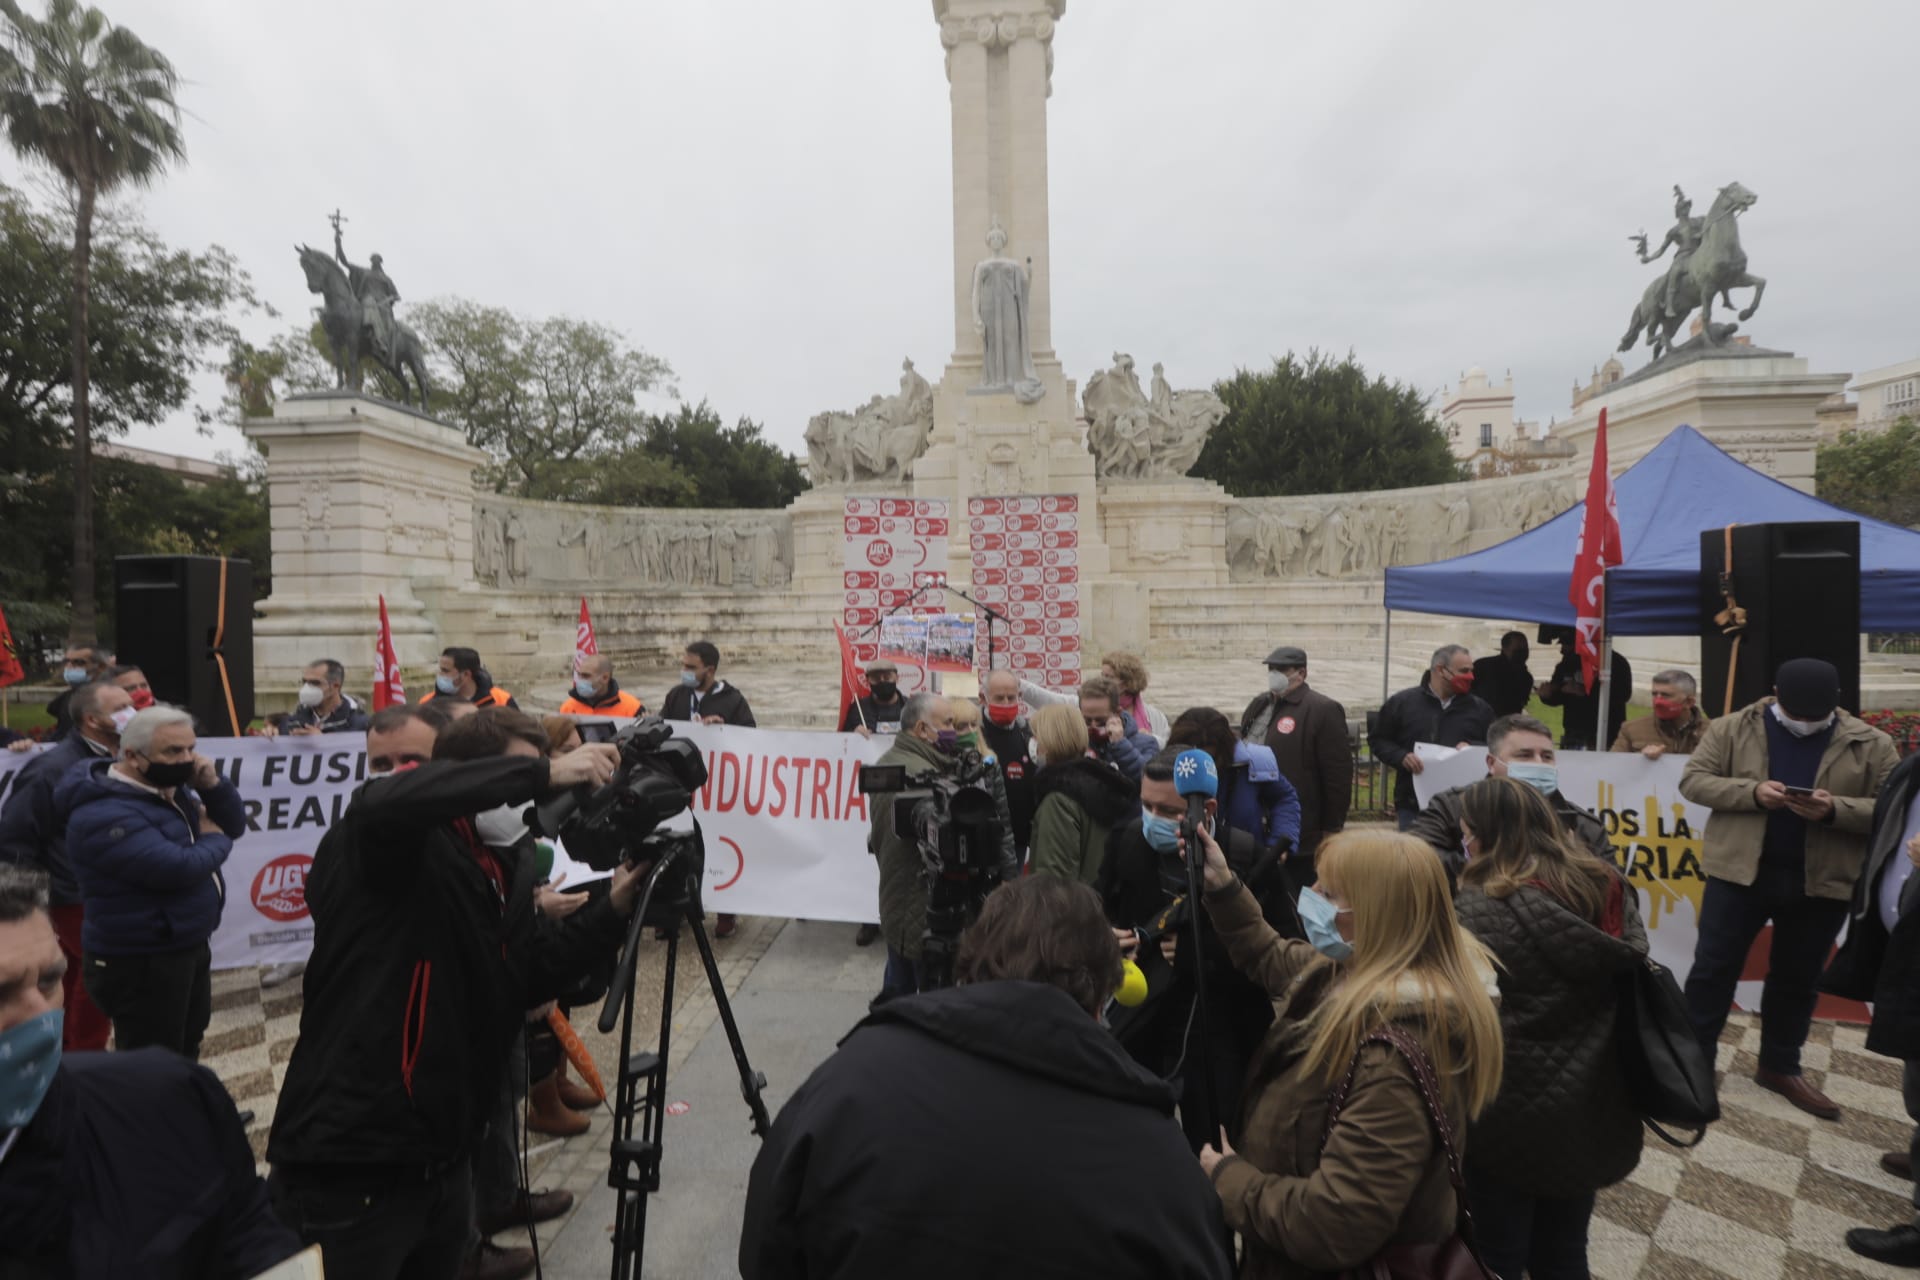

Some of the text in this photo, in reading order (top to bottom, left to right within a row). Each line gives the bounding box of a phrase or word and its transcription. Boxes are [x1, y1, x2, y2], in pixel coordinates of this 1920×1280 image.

[262, 752, 367, 788] FUSI
[690, 750, 867, 821] NDUSTRIA
[1657, 817, 1692, 839] LA
[1612, 844, 1707, 882] RIA
